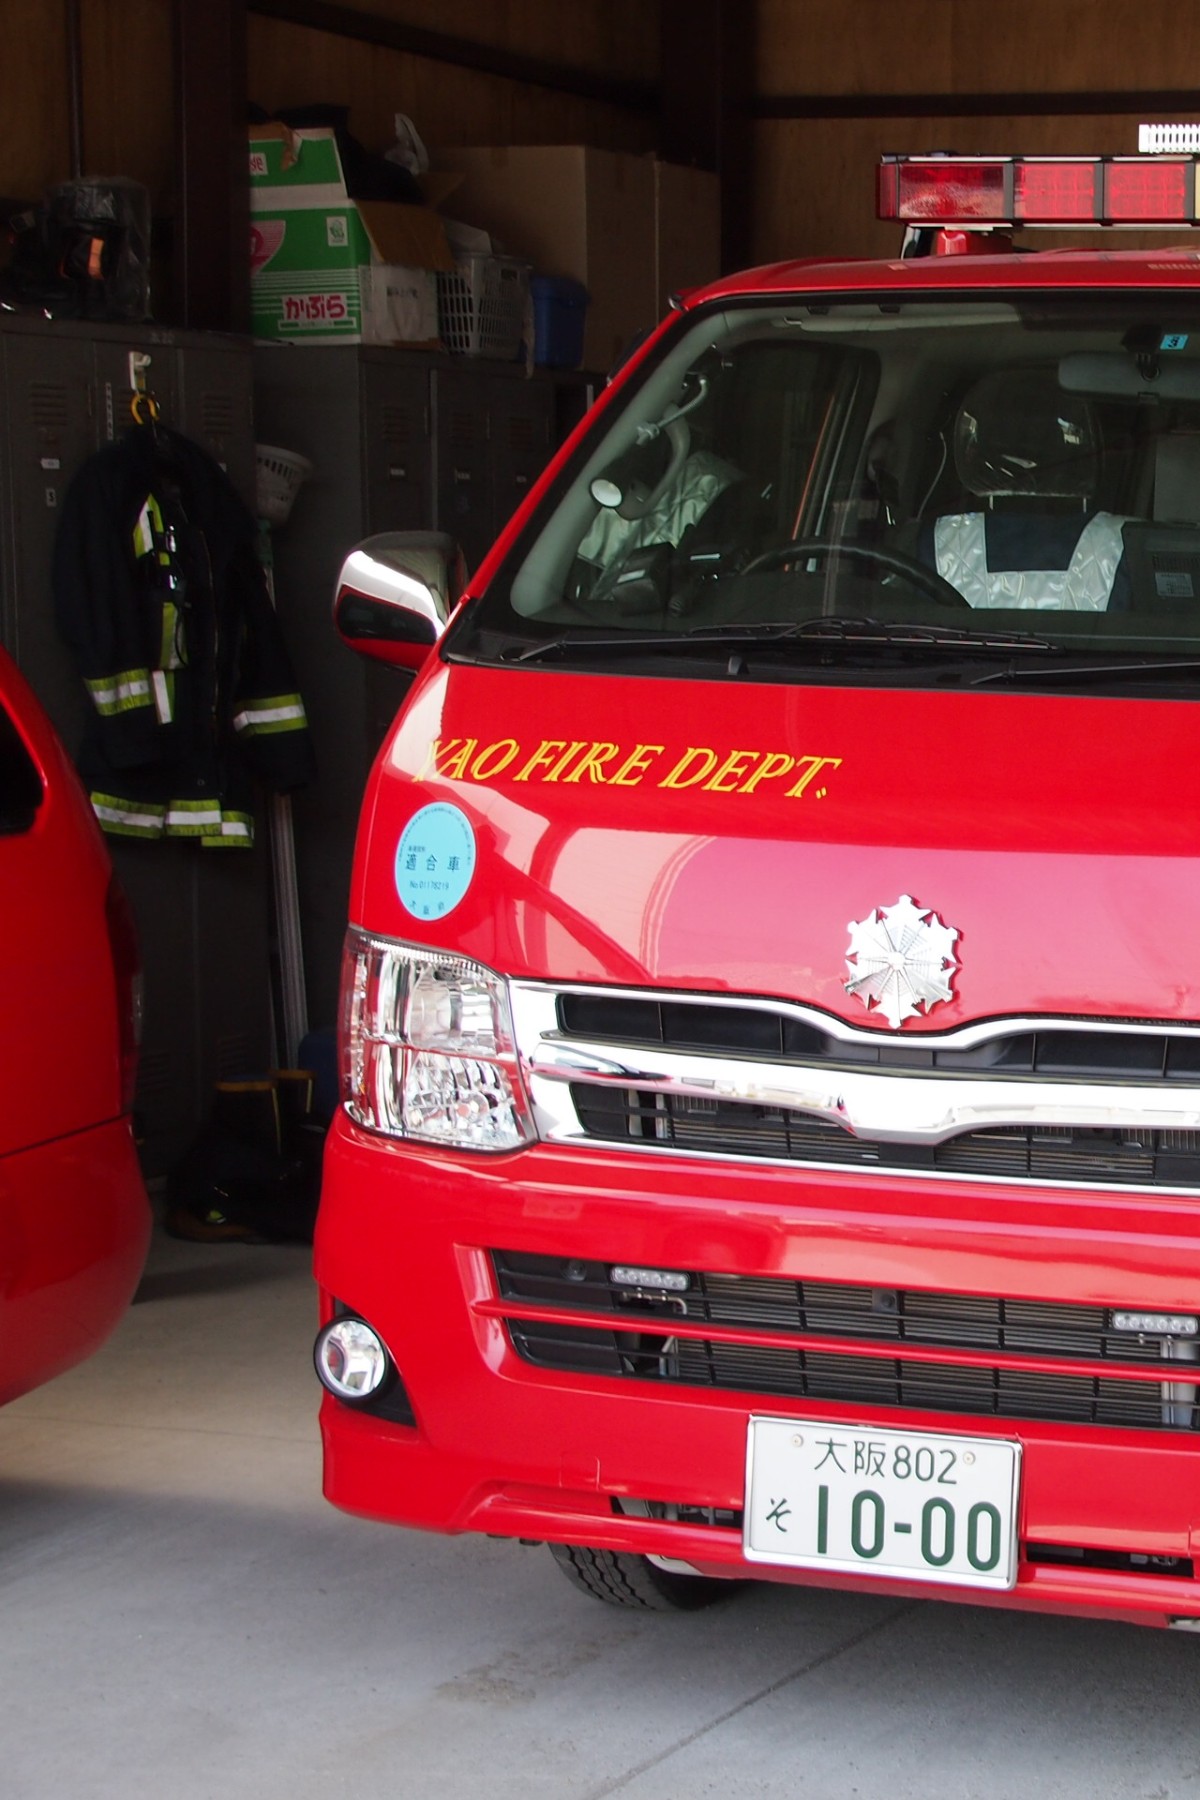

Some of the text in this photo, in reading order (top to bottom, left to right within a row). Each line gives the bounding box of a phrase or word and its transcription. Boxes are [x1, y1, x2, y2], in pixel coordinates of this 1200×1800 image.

[286, 295, 345, 319] かぶら
[412, 738, 842, 799] YAO FIRE DEPT.
[765, 1484, 1001, 1571] そ 10-00
